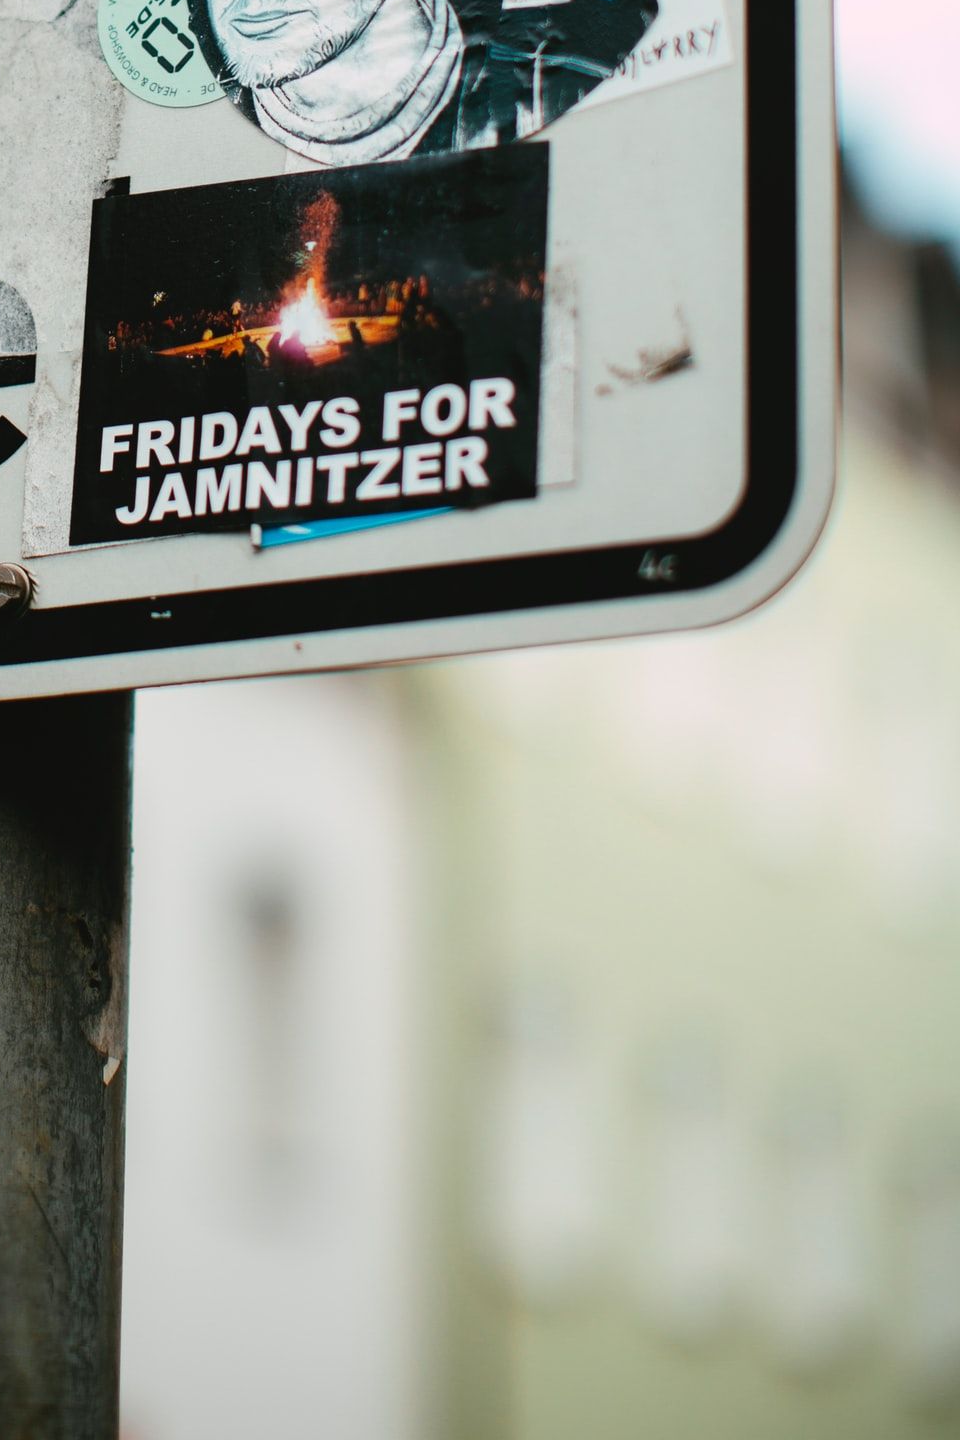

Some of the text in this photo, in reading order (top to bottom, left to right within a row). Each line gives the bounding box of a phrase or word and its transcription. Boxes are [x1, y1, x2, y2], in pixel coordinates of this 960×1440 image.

[107, 24, 146, 82] GROWSHOP
[149, 83, 178, 97] HEAD
[99, 377, 517, 473] FRIDAYS FOR
[115, 437, 490, 527] JAMNITZER
